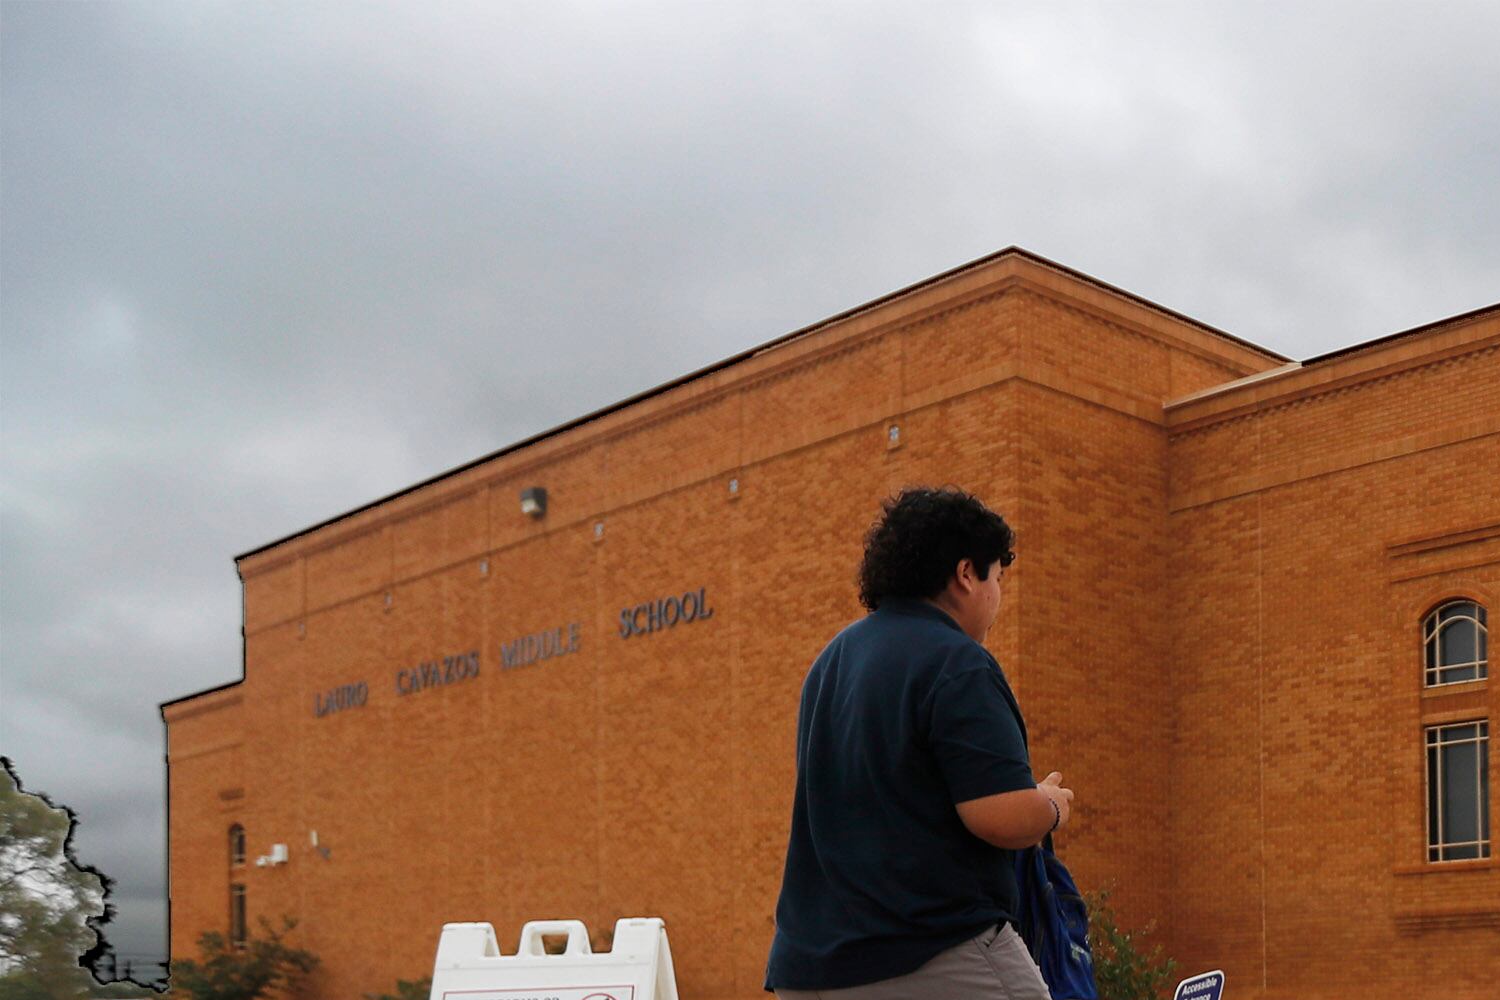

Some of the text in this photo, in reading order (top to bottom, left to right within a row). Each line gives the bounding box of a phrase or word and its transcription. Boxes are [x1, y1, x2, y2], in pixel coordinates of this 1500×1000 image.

[314, 587, 714, 718] LAURO CAVAZOS MIDDLE SCHOOL
[1182, 977, 1217, 996] Accessible
